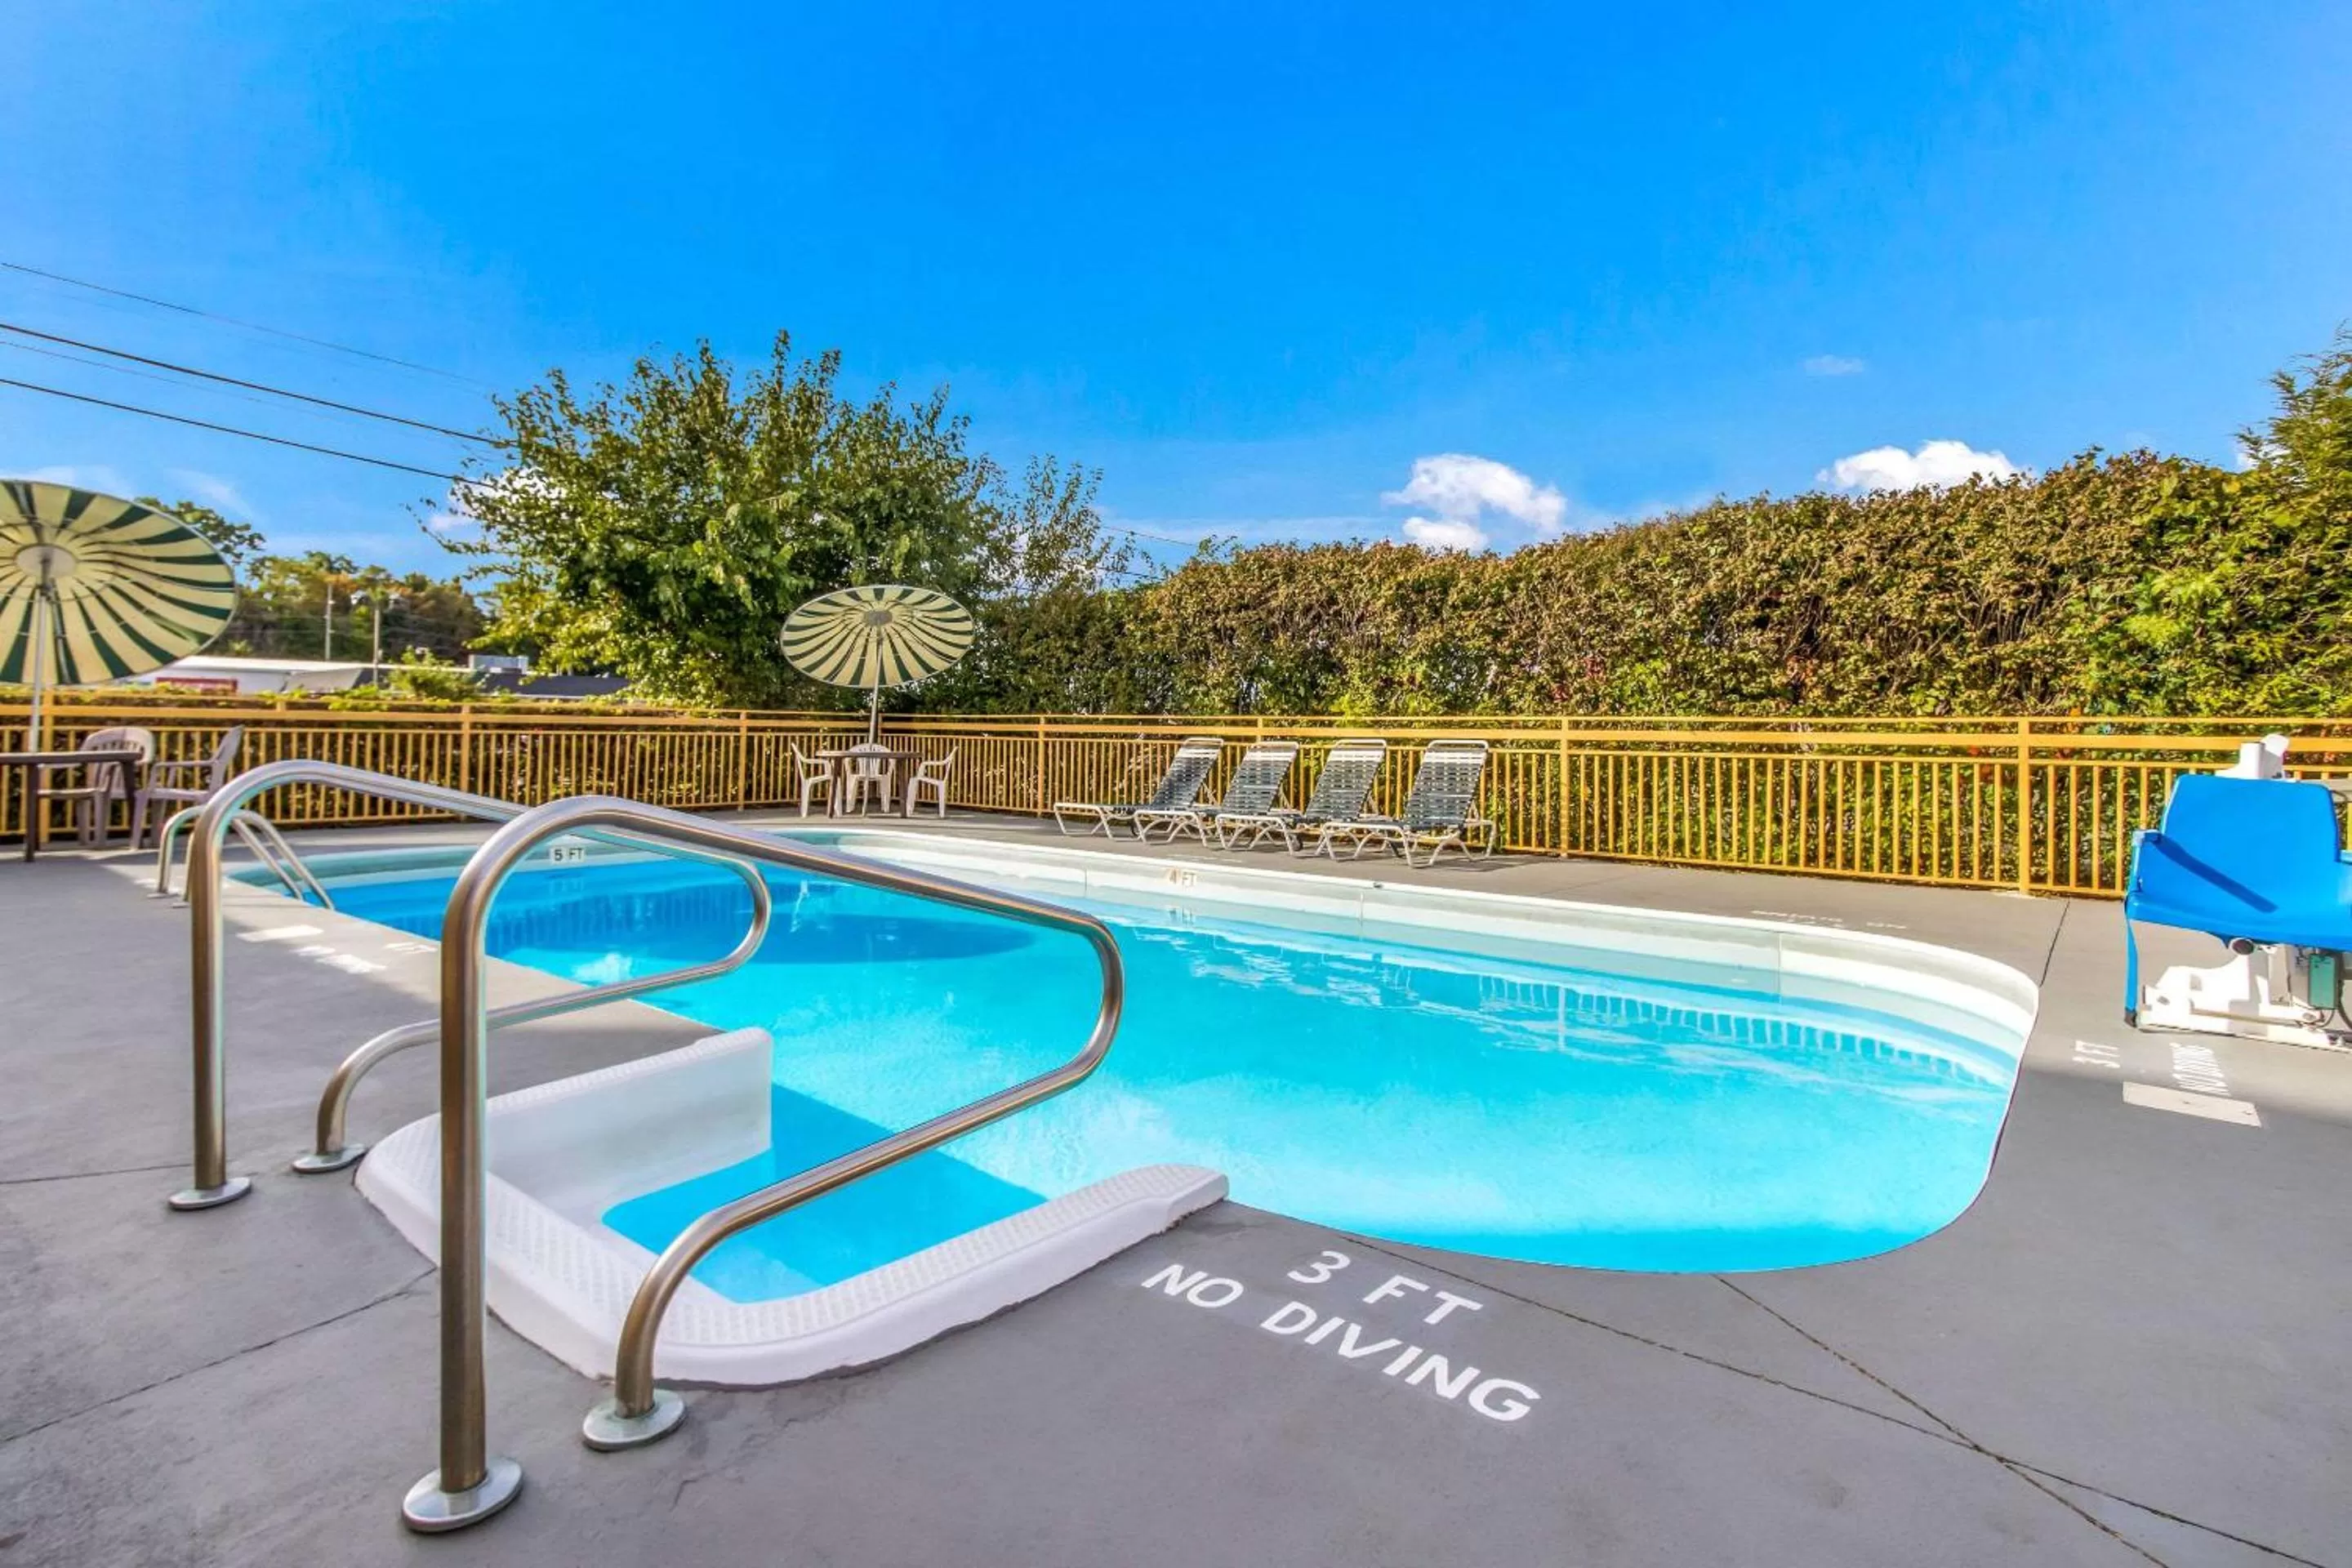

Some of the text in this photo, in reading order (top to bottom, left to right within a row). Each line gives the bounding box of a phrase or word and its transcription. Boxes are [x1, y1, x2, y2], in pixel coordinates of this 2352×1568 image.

[554, 847, 583, 862] 5 FT
[1181, 871, 1196, 887] FT
[1287, 1250, 1484, 1325] 3 FT
[1140, 1263, 1542, 1422] NO DIVING
